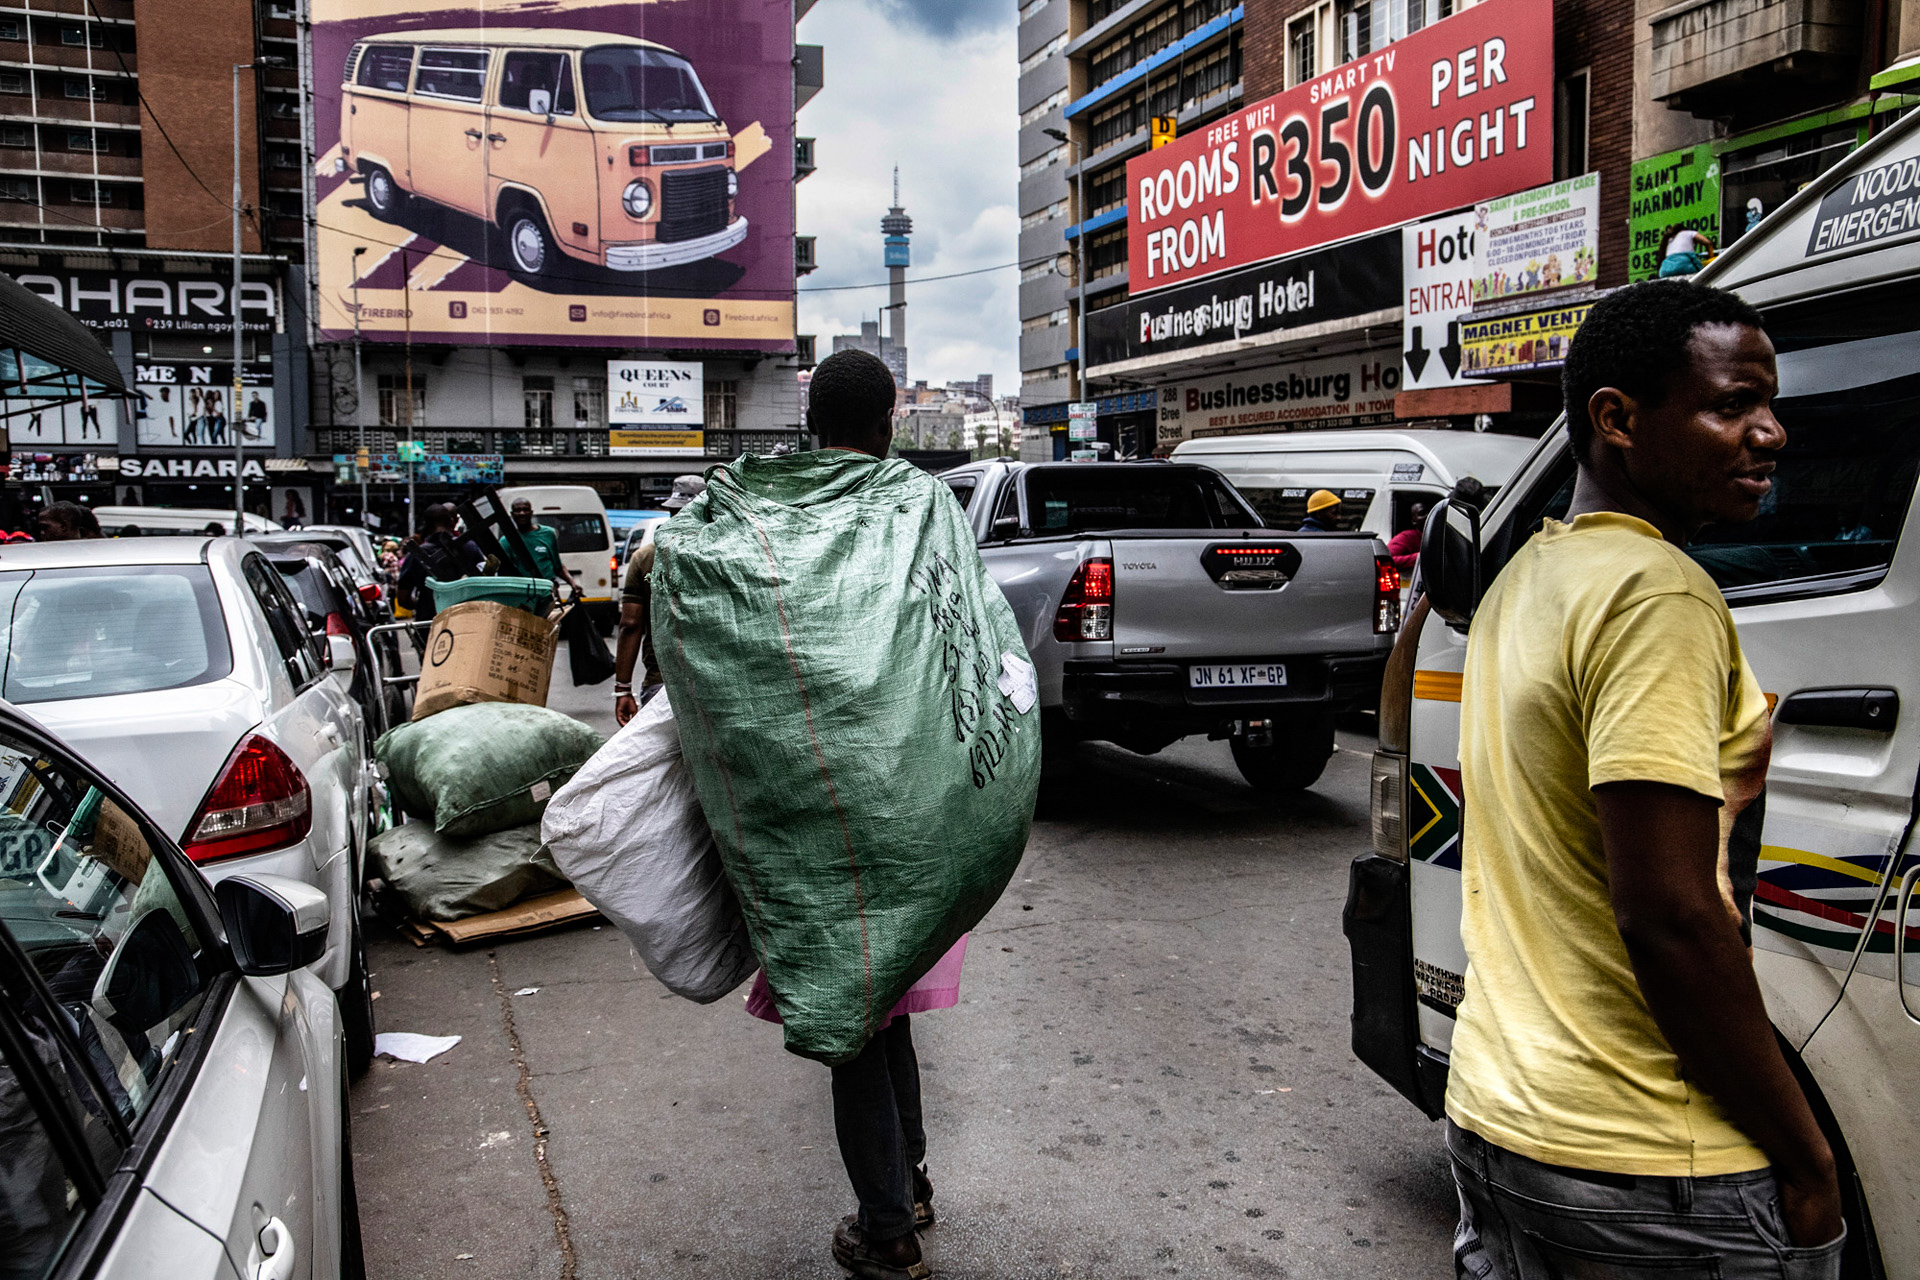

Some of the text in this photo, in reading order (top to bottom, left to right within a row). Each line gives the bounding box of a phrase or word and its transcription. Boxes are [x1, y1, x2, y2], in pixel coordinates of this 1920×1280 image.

[1310, 50, 1396, 104] SMART TV
[1430, 36, 1508, 108] PER
[1207, 102, 1276, 148] FREE WIFI
[1407, 96, 1536, 183] NIGHT
[1139, 80, 1396, 224] ROOMS R350
[1635, 163, 1680, 192] SAINT
[1490, 175, 1596, 213] SAINT HARMONY DAY CARE
[1632, 179, 1705, 219] HARMONY
[1520, 198, 1570, 219] PRE-SCHOOL
[1560, 219, 1584, 233] YEARS
[1814, 194, 1920, 252] EMERGEN
[1146, 209, 1226, 279] FROM
[1561, 229, 1587, 241] FRIDAY
[12, 274, 275, 317] AHARA
[361, 308, 413, 319] FIREBIRD
[724, 313, 779, 323] firebird.africa
[153, 319, 173, 330] 239
[176, 319, 205, 331] Lilian
[1464, 317, 1534, 340] MAGNET
[136, 365, 177, 383] ME
[189, 366, 212, 384] N
[620, 368, 691, 382] QUEENS
[1185, 362, 1402, 412] Businessburg Ho
[1161, 406, 1180, 422] Bree
[1209, 415, 1229, 427] BEST
[1230, 414, 1237, 424] &
[1237, 408, 1276, 424] SECURED
[1277, 402, 1350, 421] ACCOMODATION
[1355, 401, 1366, 413] IN
[1158, 423, 1183, 440] Street
[120, 458, 265, 477] SAHARA
[1123, 562, 1157, 570] TOYOTA
[1234, 556, 1275, 566] HILUX
[1195, 667, 1284, 684] JN 61 XF GP
